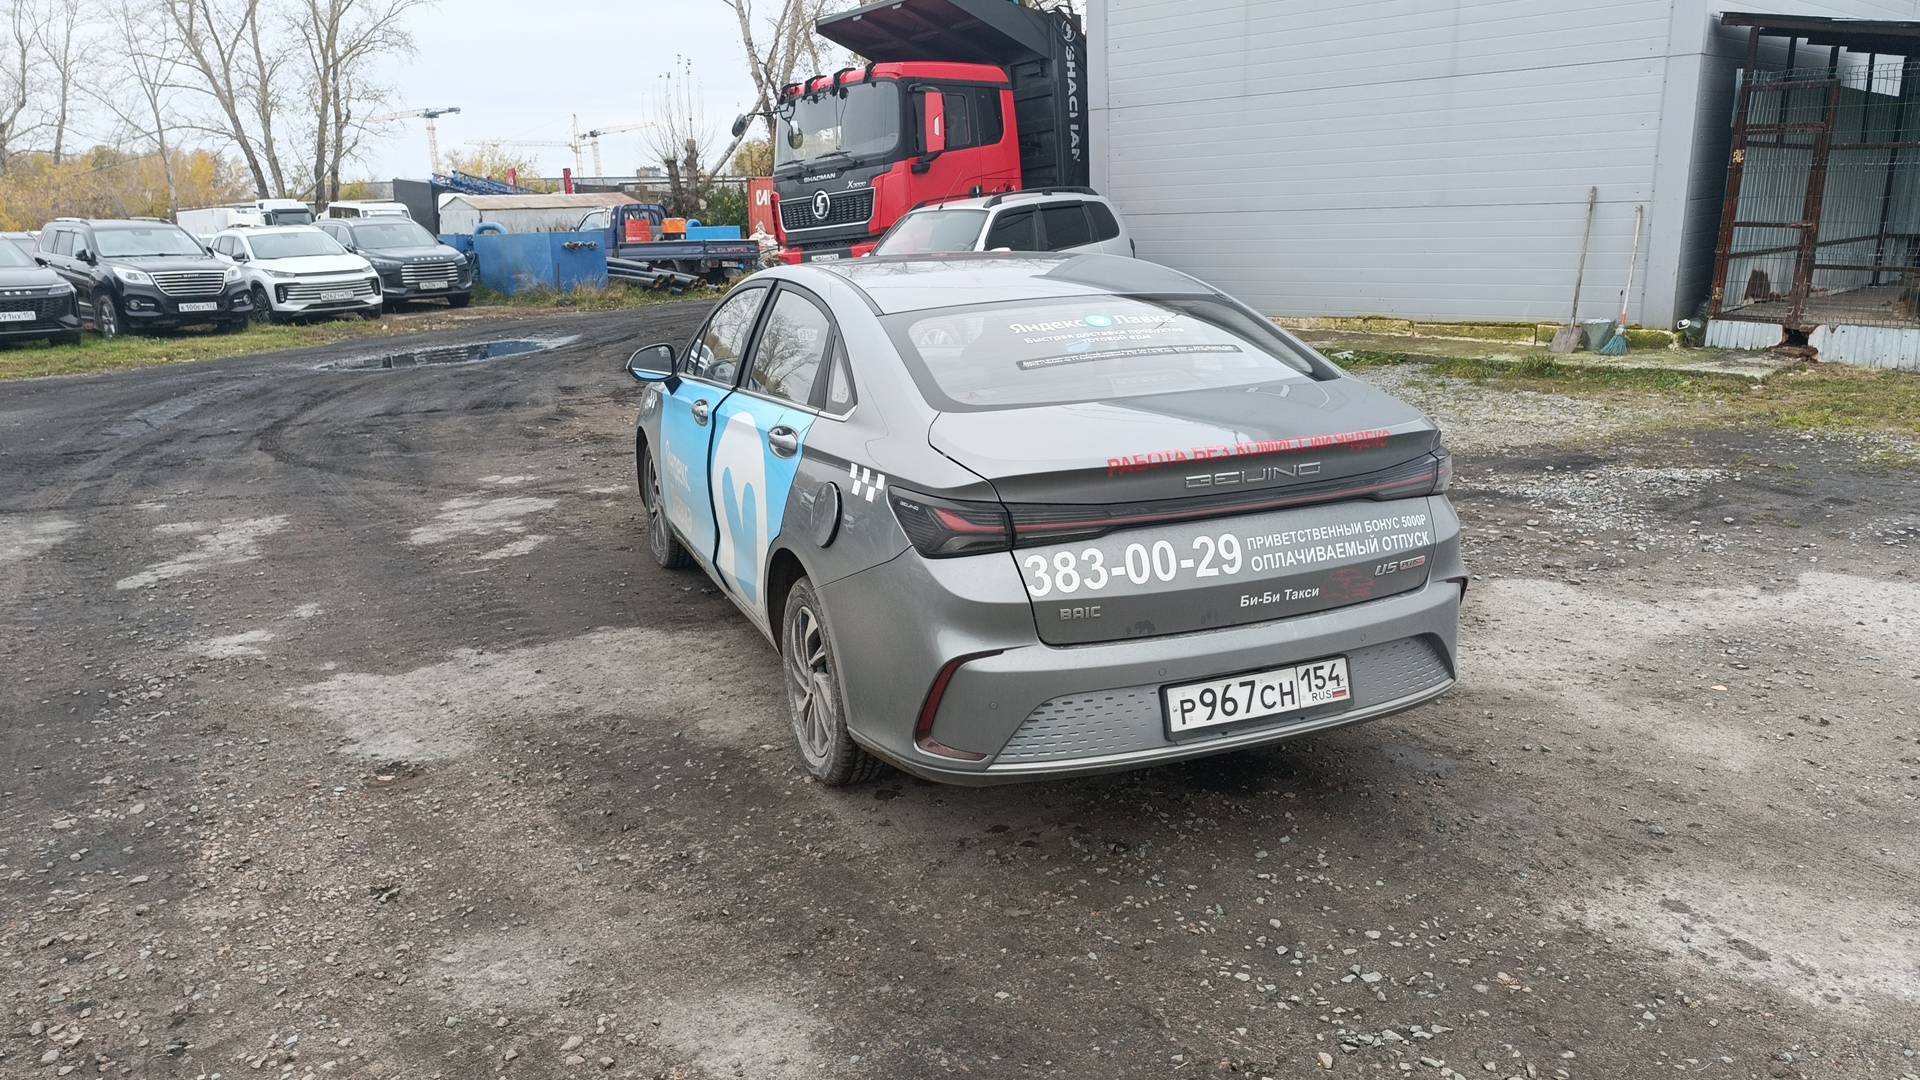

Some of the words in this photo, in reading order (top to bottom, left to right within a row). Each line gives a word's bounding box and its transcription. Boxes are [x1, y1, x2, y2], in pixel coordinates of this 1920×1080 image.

[803, 172, 836, 183] SHACMAN
[1009, 317, 1089, 334] Яндекс
[1113, 314, 1178, 326] Лавка
[1107, 448, 1187, 478] РАБОТА
[1191, 443, 1231, 462] БЕЗ
[1185, 461, 1321, 488] BEIJING
[1364, 517, 1400, 532] БОНУС
[1251, 535, 1379, 572] ОПЛАЧИВАЕМЫЙ
[1382, 531, 1431, 552] ОТПУСК
[1024, 533, 1243, 597] 383-00-29
[1374, 560, 1400, 577] U5
[1240, 591, 1280, 608] Би-Би
[1284, 586, 1320, 601] Такси
[1060, 605, 1101, 621] BAIC
[1180, 680, 1296, 725] Р967СН
[1300, 663, 1341, 693] 154
[1312, 690, 1332, 702] RUS
